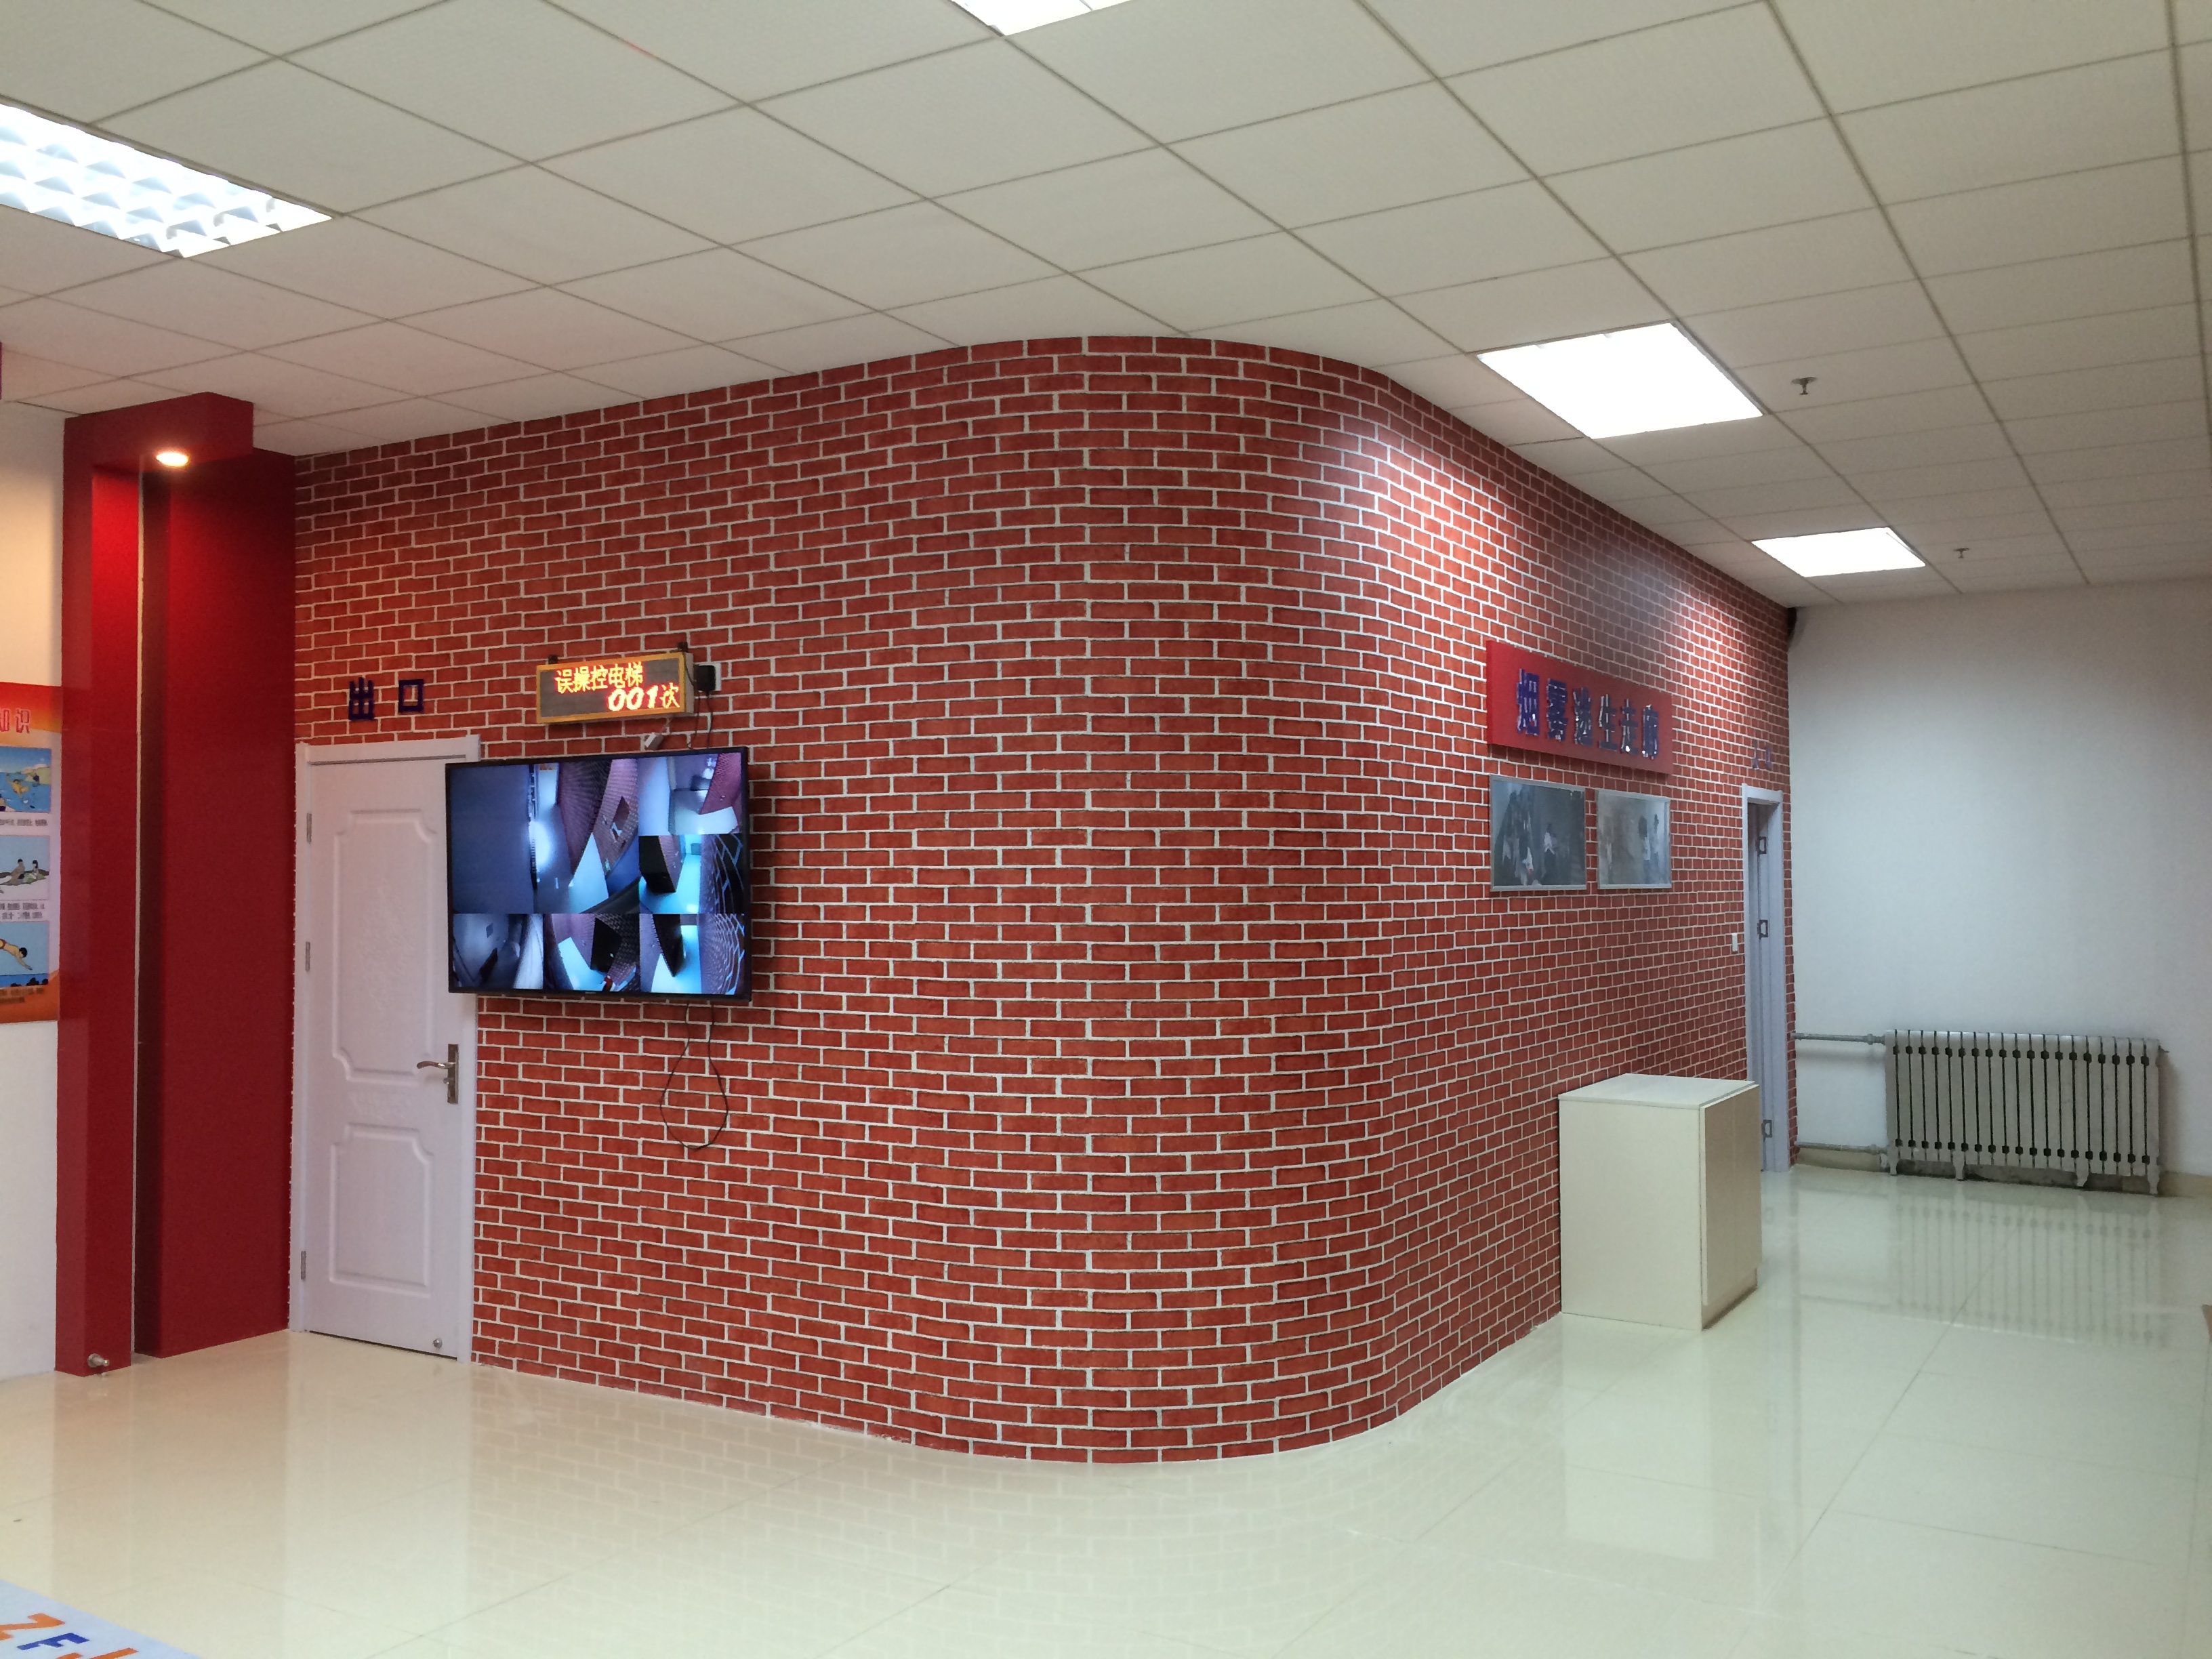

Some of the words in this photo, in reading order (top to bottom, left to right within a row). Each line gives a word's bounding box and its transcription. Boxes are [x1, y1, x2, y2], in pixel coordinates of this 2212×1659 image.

[555, 661, 644, 694] 误操控电梯
[348, 677, 424, 721] 出口
[608, 682, 680, 712] 001次
